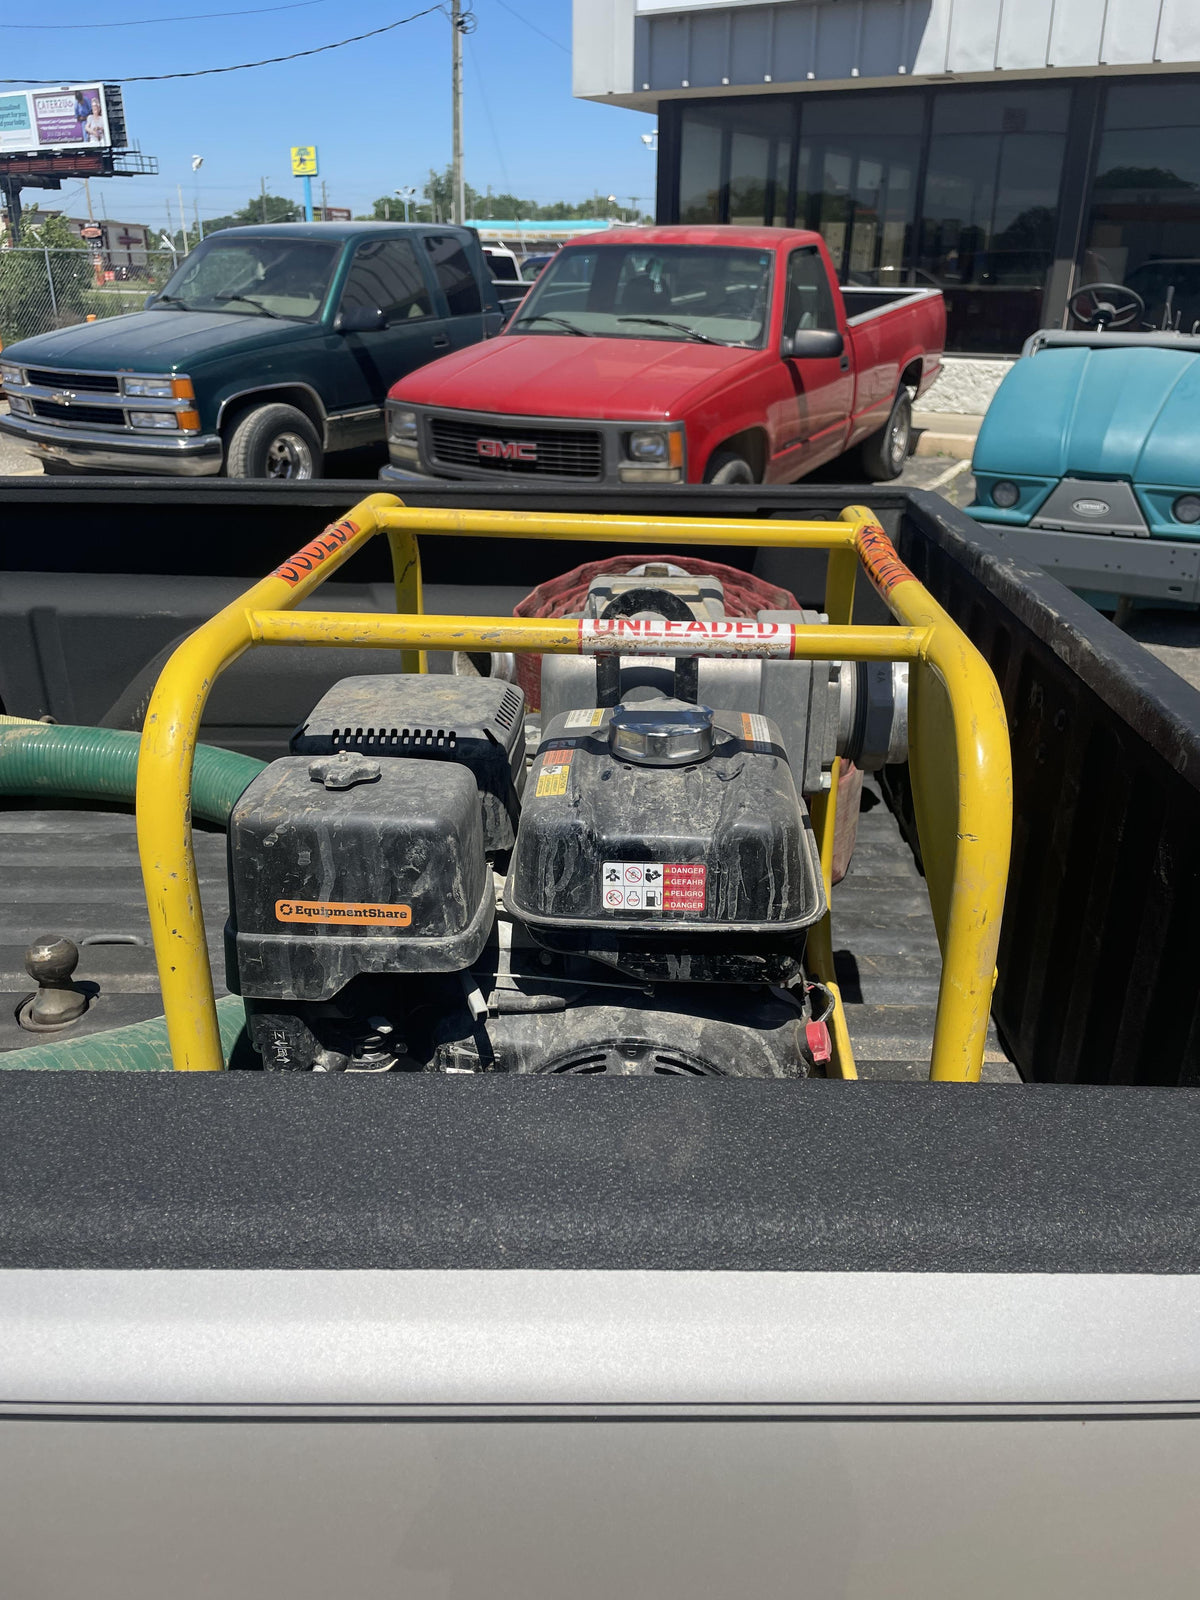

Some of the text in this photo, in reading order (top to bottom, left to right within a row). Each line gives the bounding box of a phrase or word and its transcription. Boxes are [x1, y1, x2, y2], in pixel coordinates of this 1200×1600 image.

[476, 439, 537, 460] GMC
[592, 618, 779, 639] UNLEADED
[295, 905, 408, 918] EquipmentShare
